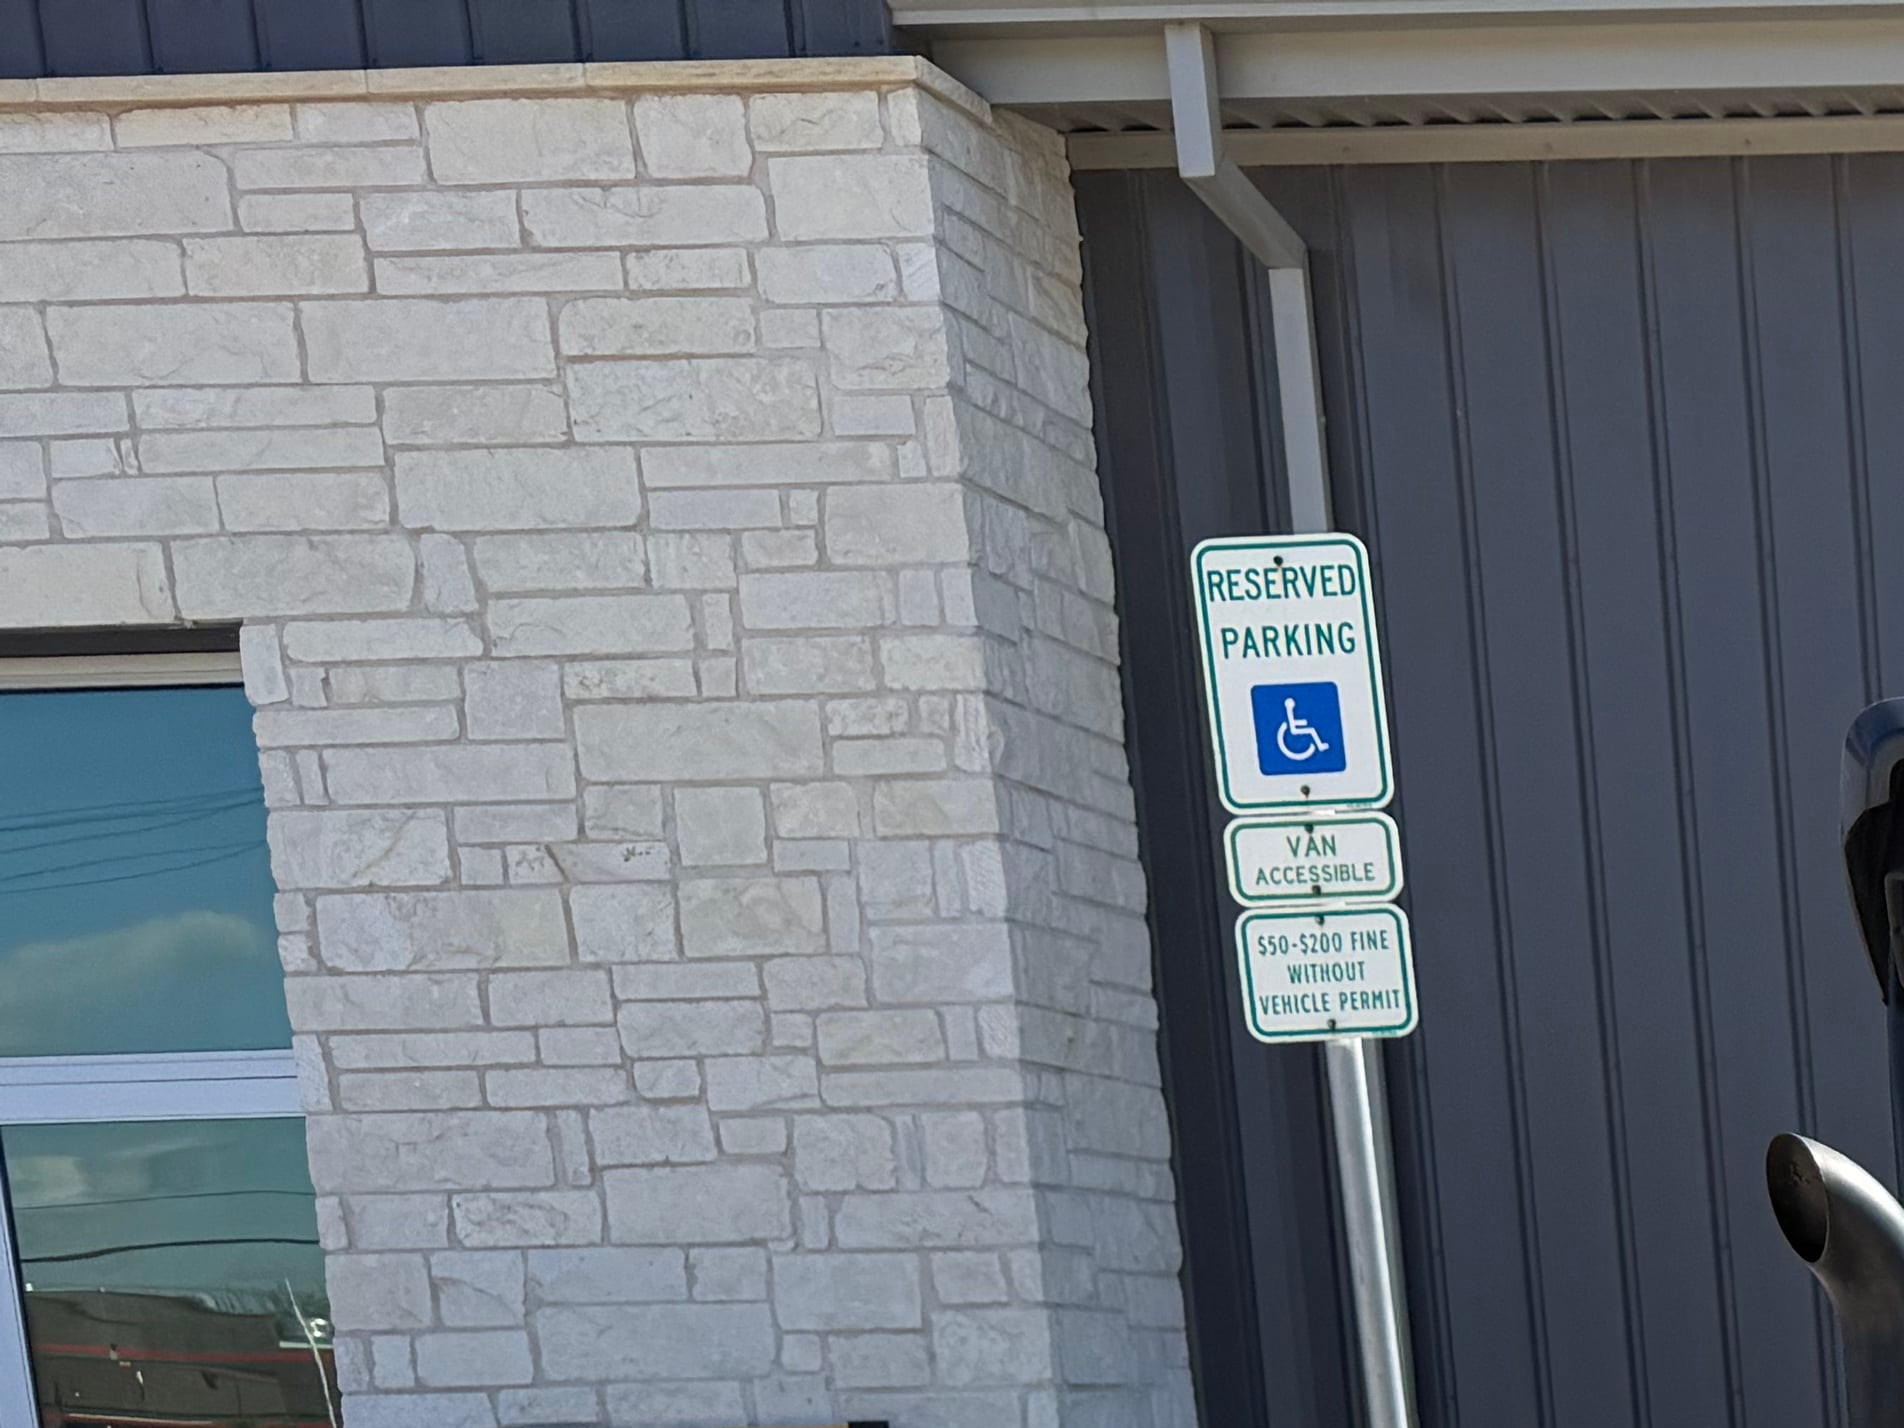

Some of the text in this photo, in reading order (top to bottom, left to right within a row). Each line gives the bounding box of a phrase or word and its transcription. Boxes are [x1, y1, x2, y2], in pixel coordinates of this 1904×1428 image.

[1206, 563, 1356, 602] RESERVED
[1220, 621, 1356, 659] PARKING
[1287, 834, 1337, 858] VAN
[1255, 862, 1375, 885] ACCESSIBLE
[1258, 930, 1389, 956] $50-$200 FINE
[1288, 961, 1366, 984] WITHOUT
[1259, 988, 1400, 1016] VEHICLE PERMIT
